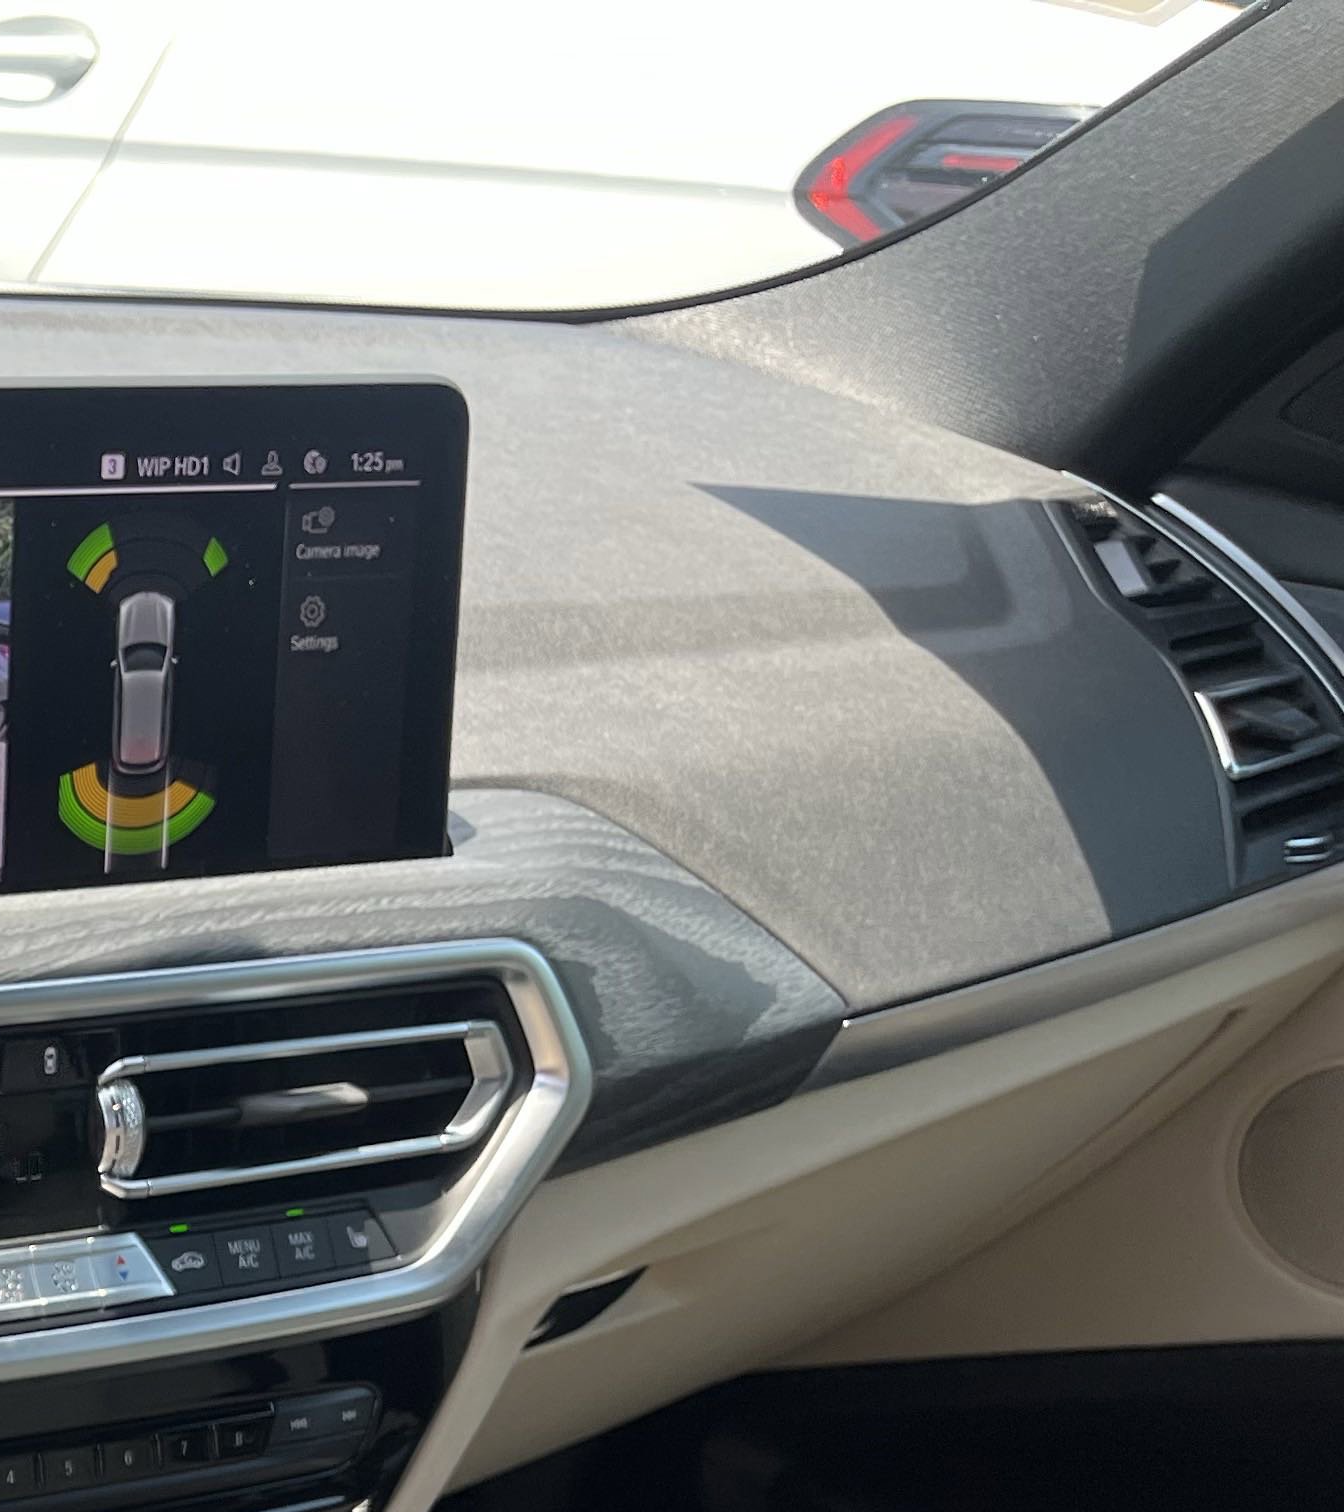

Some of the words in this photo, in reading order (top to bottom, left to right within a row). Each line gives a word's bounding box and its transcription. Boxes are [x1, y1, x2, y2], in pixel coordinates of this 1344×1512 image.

[137, 456, 171, 477] WIP
[174, 455, 209, 476] HD1
[351, 452, 383, 472] 1:25
[296, 543, 342, 560] Camera
[343, 543, 381, 560] image
[290, 635, 339, 653] Settings
[227, 1239, 261, 1255] MENU
[288, 1231, 313, 1246] MAX
[180, 1439, 188, 1456] 7
[124, 1449, 133, 1466] 6
[64, 1459, 73, 1476] 5
[6, 1469, 15, 1486] 4
